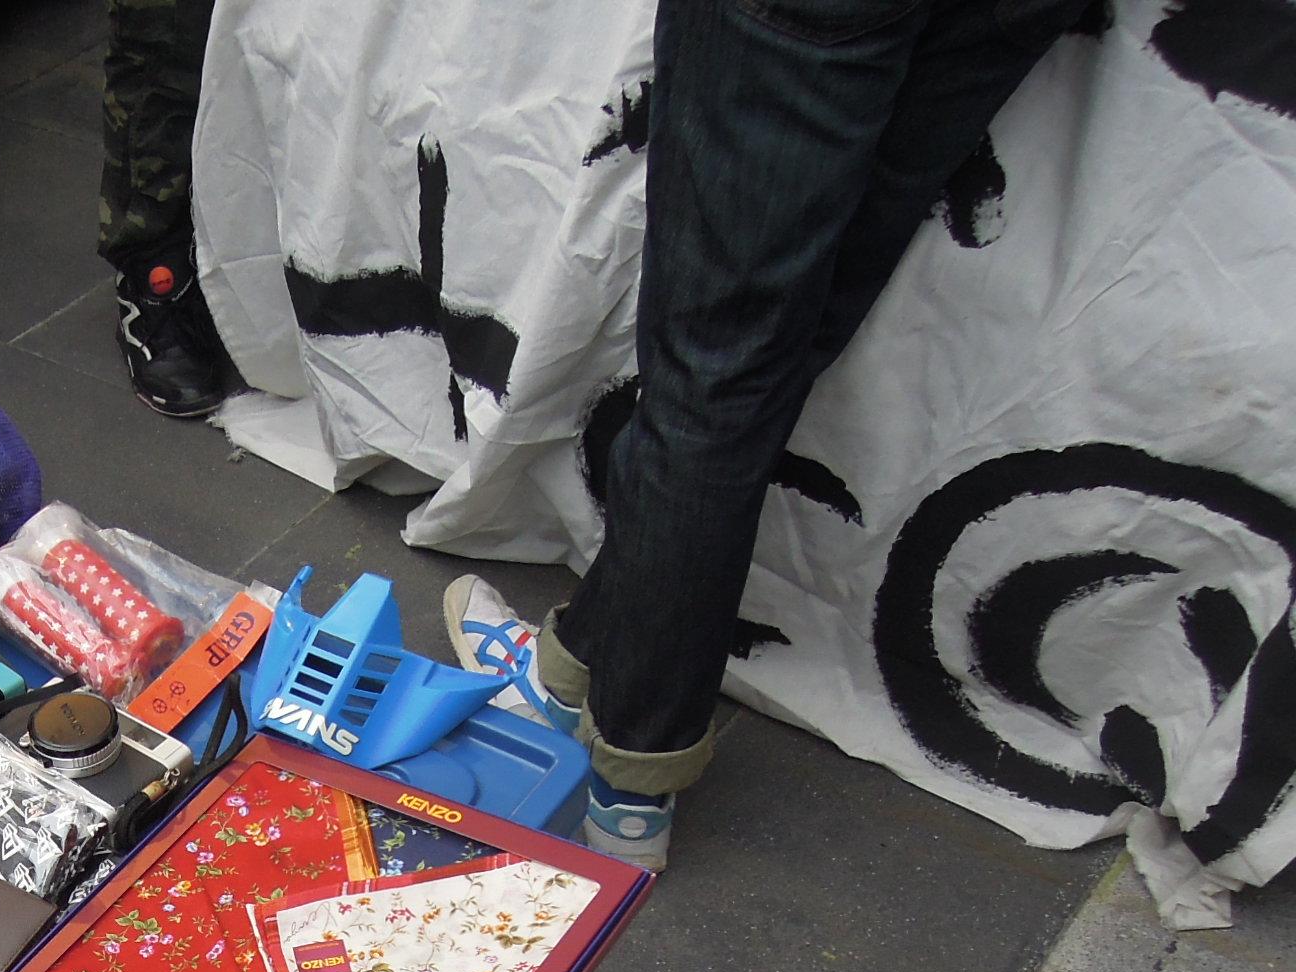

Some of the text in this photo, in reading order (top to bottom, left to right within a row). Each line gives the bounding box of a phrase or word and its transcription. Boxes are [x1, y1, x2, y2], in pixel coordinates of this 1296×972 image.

[204, 610, 255, 667] GRIP
[259, 697, 360, 757] VANS
[397, 793, 462, 824] KENZO
[301, 955, 345, 971] KENZO
